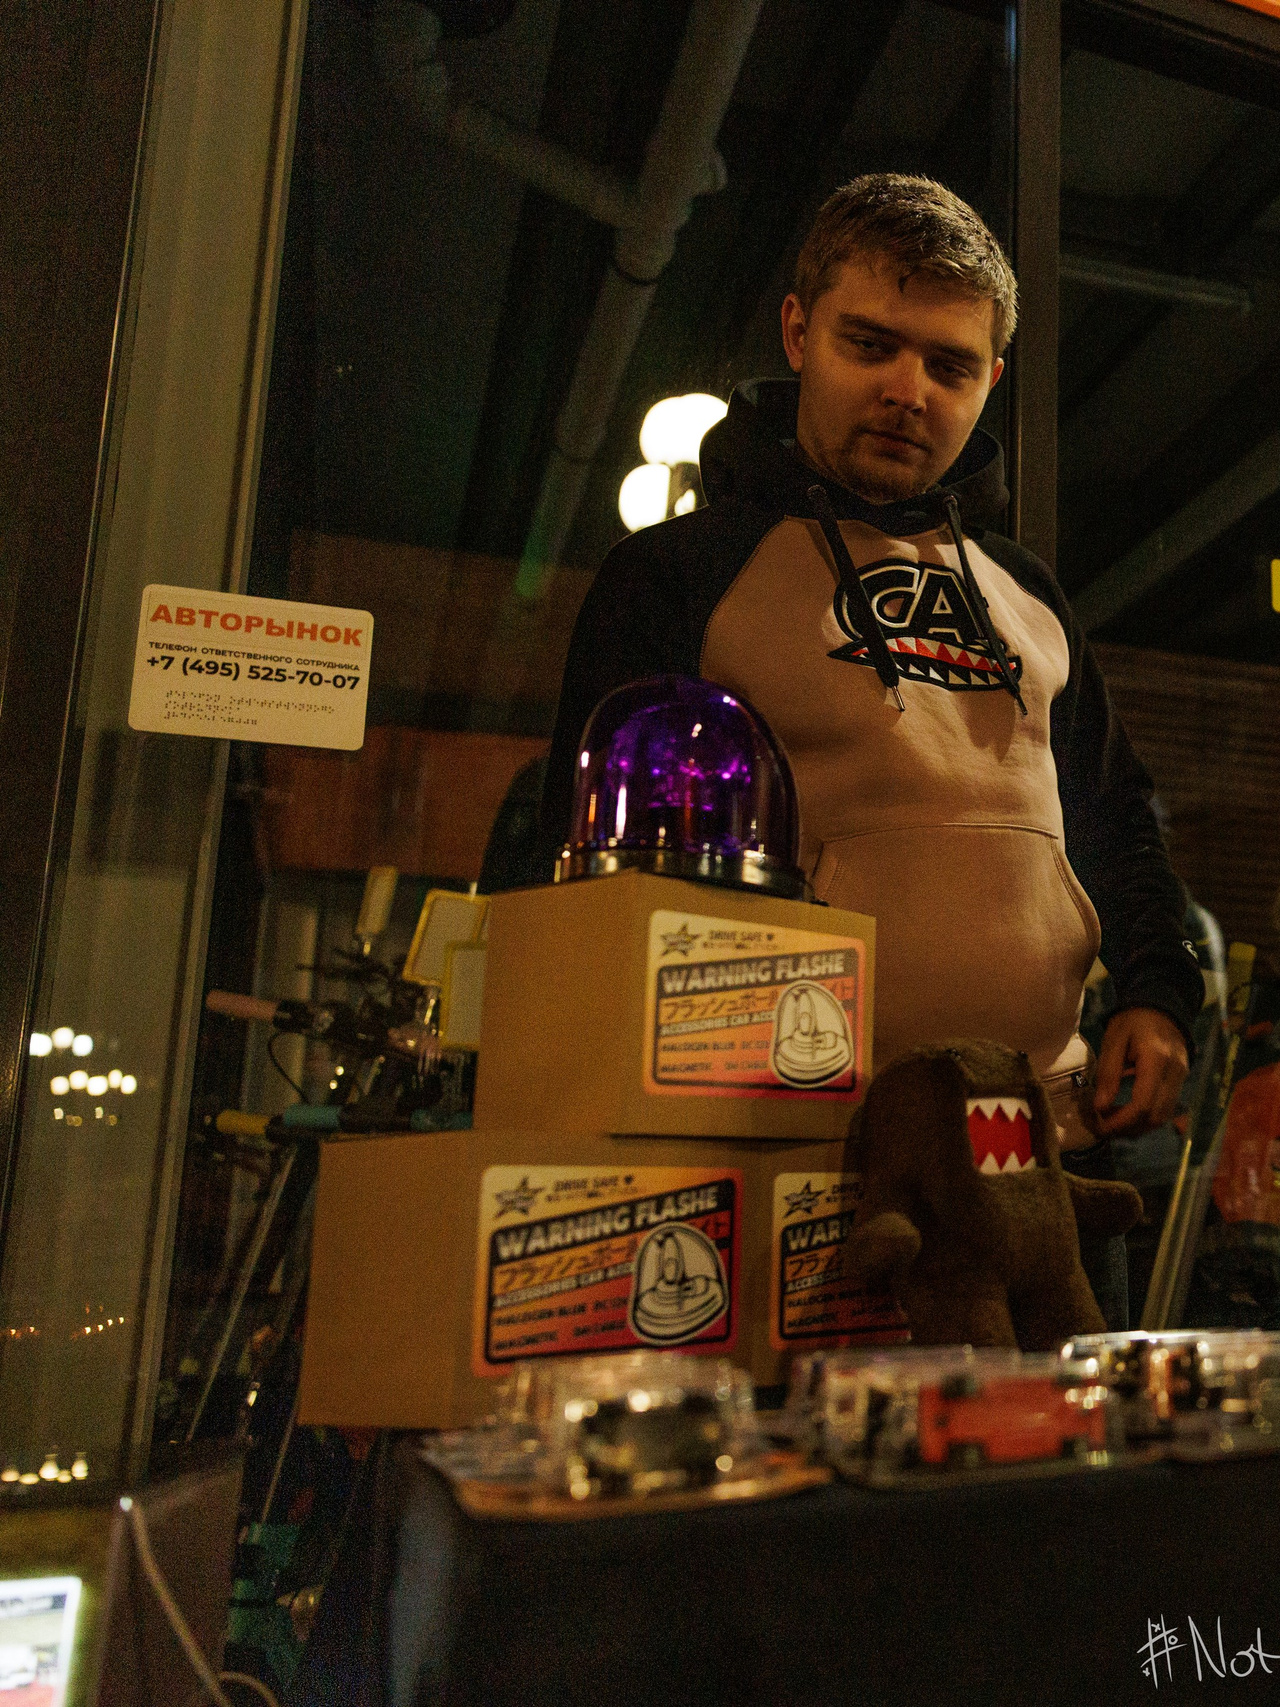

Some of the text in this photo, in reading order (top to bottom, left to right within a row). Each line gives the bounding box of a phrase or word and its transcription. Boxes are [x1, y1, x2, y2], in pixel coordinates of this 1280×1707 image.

[149, 603, 363, 647] АВТОРЫНОК
[146, 655, 361, 690] +7 (495) 525-70-07
[148, 641, 360, 672] ТЕЛЕФОН ОТВЕТСТВЕННОГО СОТРУДНИКА
[661, 959, 772, 994] WARNING
[495, 1205, 630, 1260] WARNING
